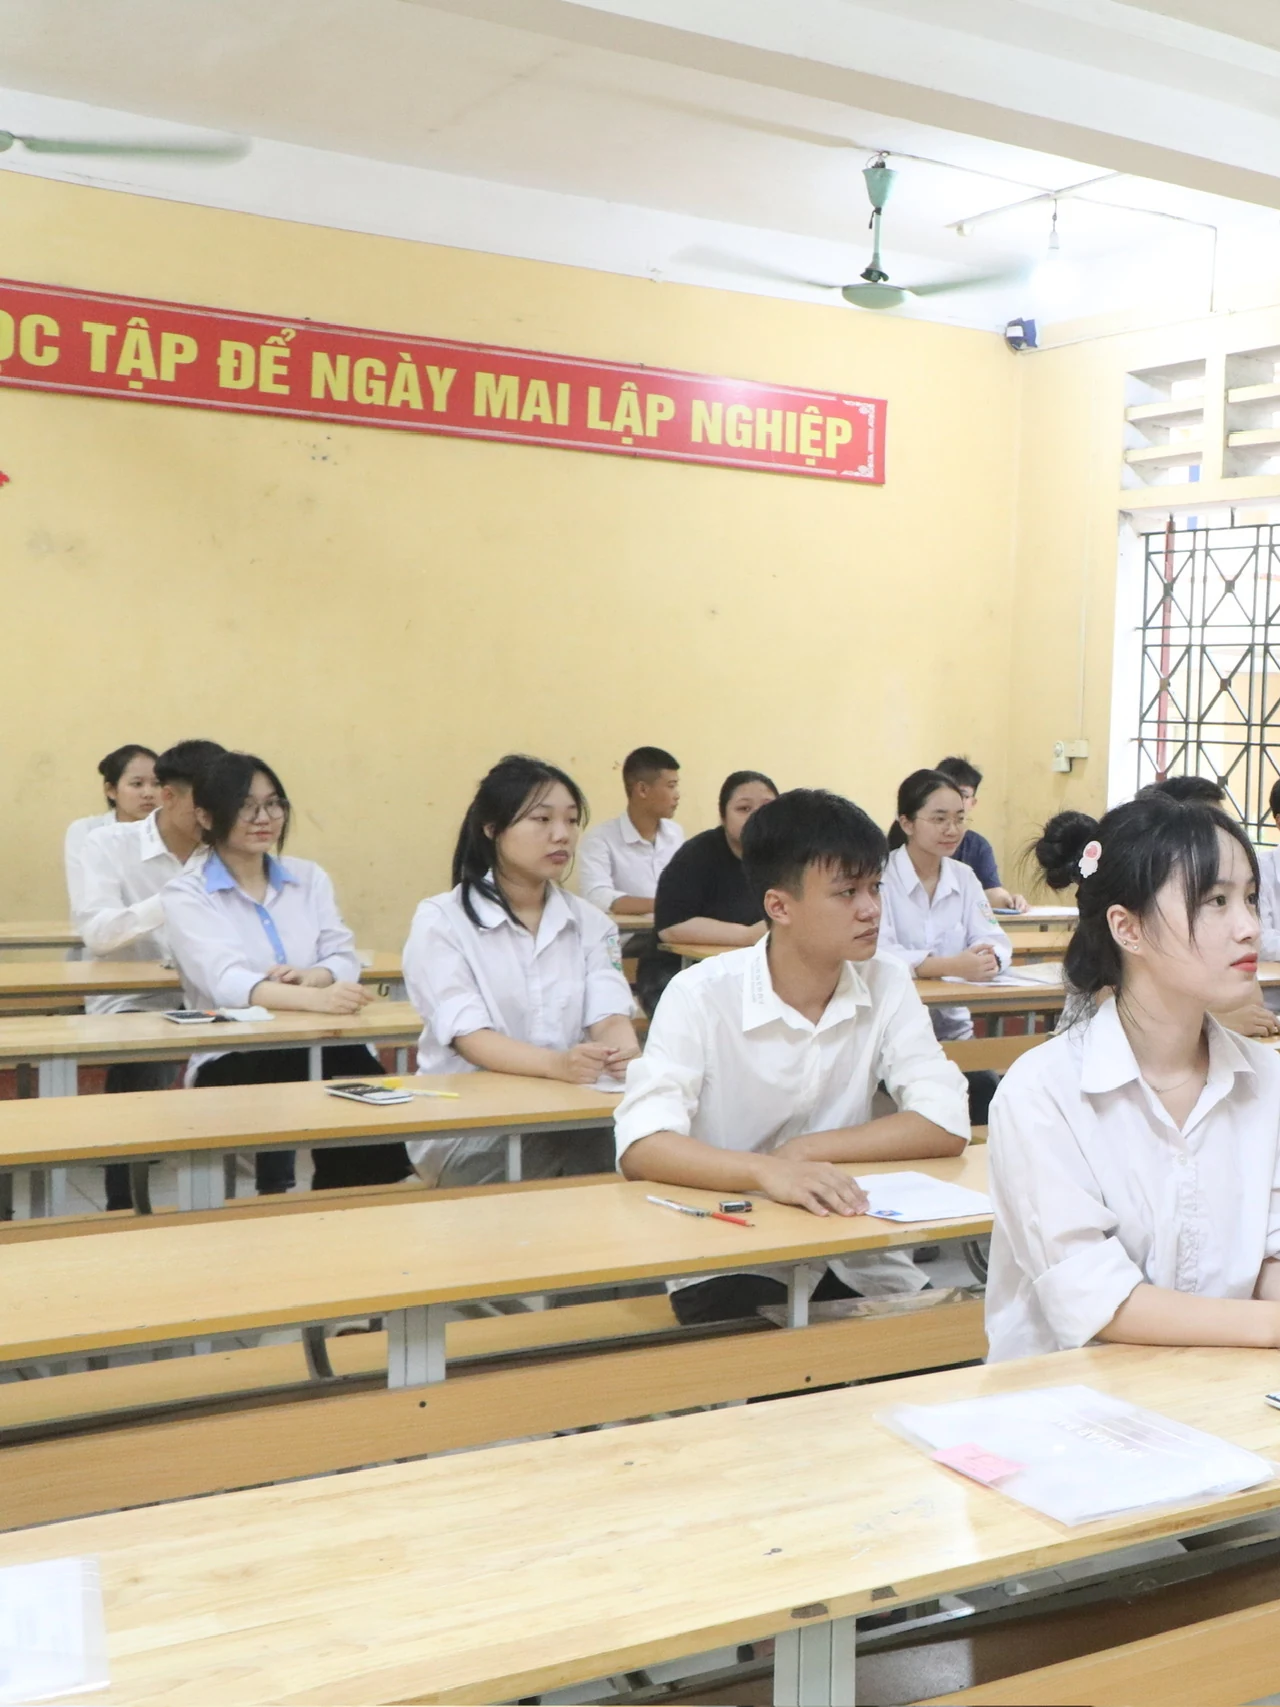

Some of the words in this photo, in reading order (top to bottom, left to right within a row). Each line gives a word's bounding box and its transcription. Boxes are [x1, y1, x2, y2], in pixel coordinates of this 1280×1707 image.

[82, 316, 198, 389] TẬP
[216, 328, 296, 395] ĐỂ
[311, 352, 457, 412] NGÀY
[473, 371, 569, 426] MAI
[587, 381, 675, 445] LẬP
[691, 400, 852, 466] NGHIỆP
